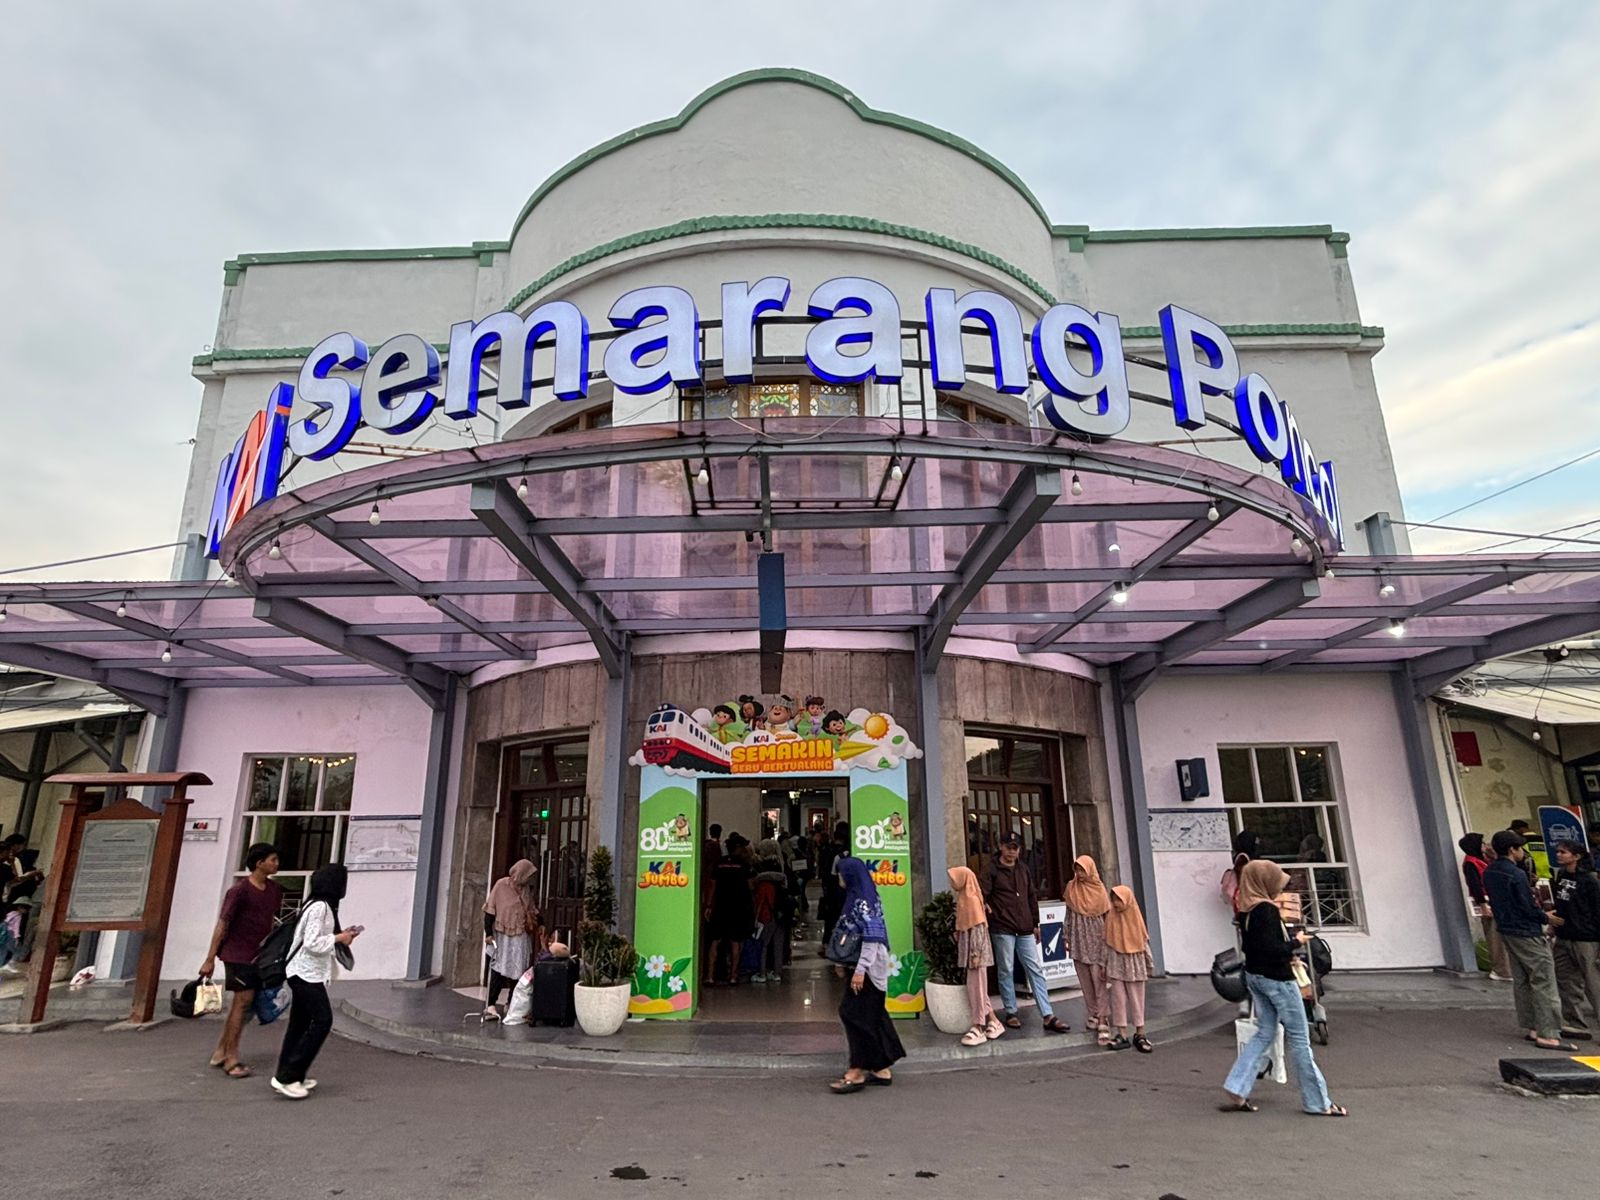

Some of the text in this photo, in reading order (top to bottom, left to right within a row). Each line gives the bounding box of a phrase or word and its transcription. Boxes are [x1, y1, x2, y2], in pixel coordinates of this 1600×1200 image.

[204, 276, 1345, 560] KAI Semarang Poncol
[649, 724, 667, 733] KAI
[753, 735, 769, 743] KAI
[731, 739, 833, 763] SEMAKIN
[732, 759, 833, 773] SERU BERTUALANG
[649, 861, 682, 874] KAI
[866, 859, 898, 873] KAI
[639, 870, 689, 889] JUMBO
